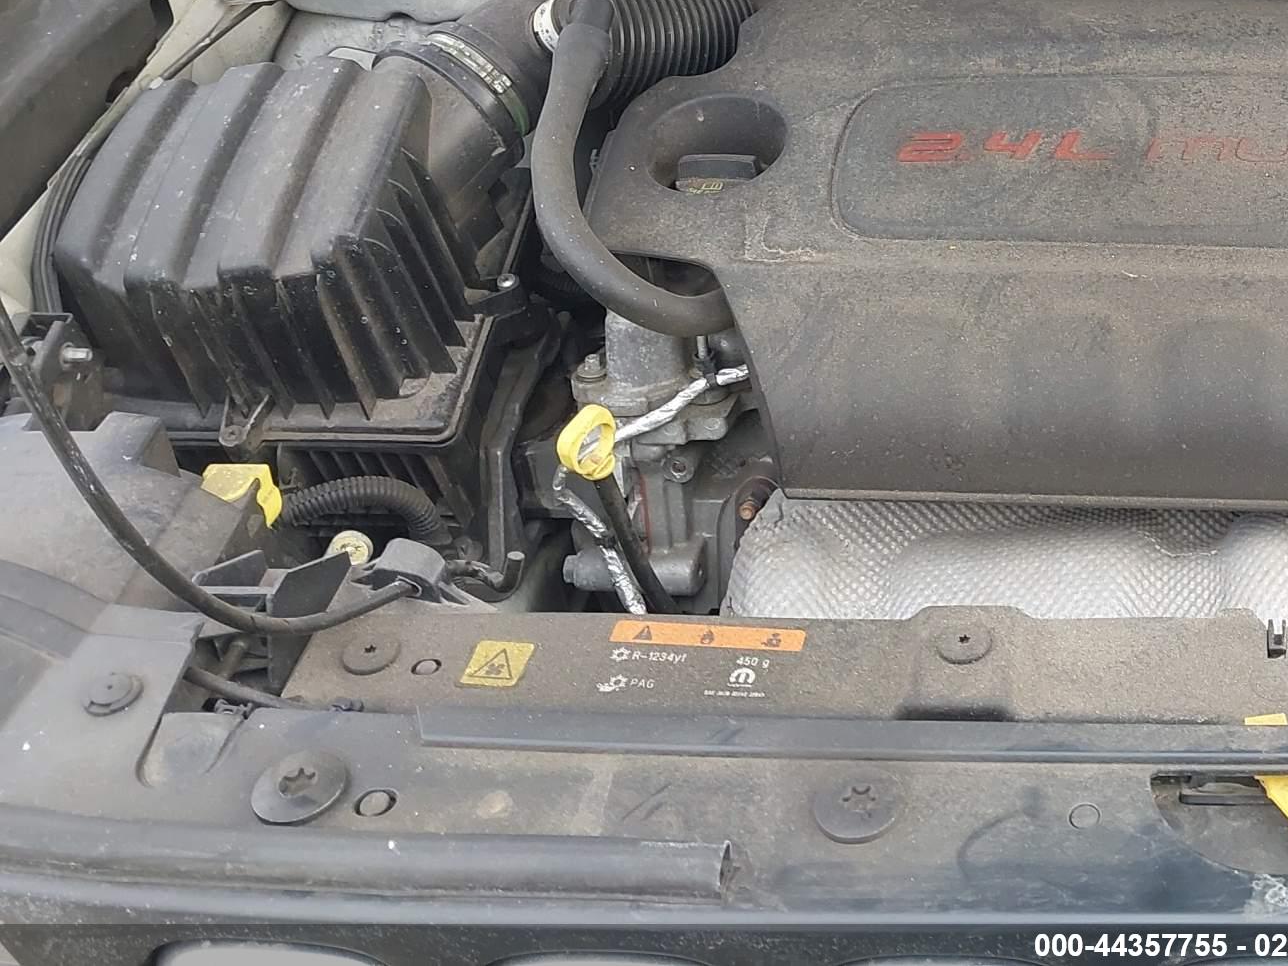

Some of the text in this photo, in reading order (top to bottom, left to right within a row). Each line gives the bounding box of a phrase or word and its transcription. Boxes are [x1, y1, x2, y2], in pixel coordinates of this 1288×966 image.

[896, 130, 1112, 164] 2.4L
[631, 650, 688, 665] R-1234yf
[735, 656, 770, 668] 450 g
[630, 677, 656, 689] PAG
